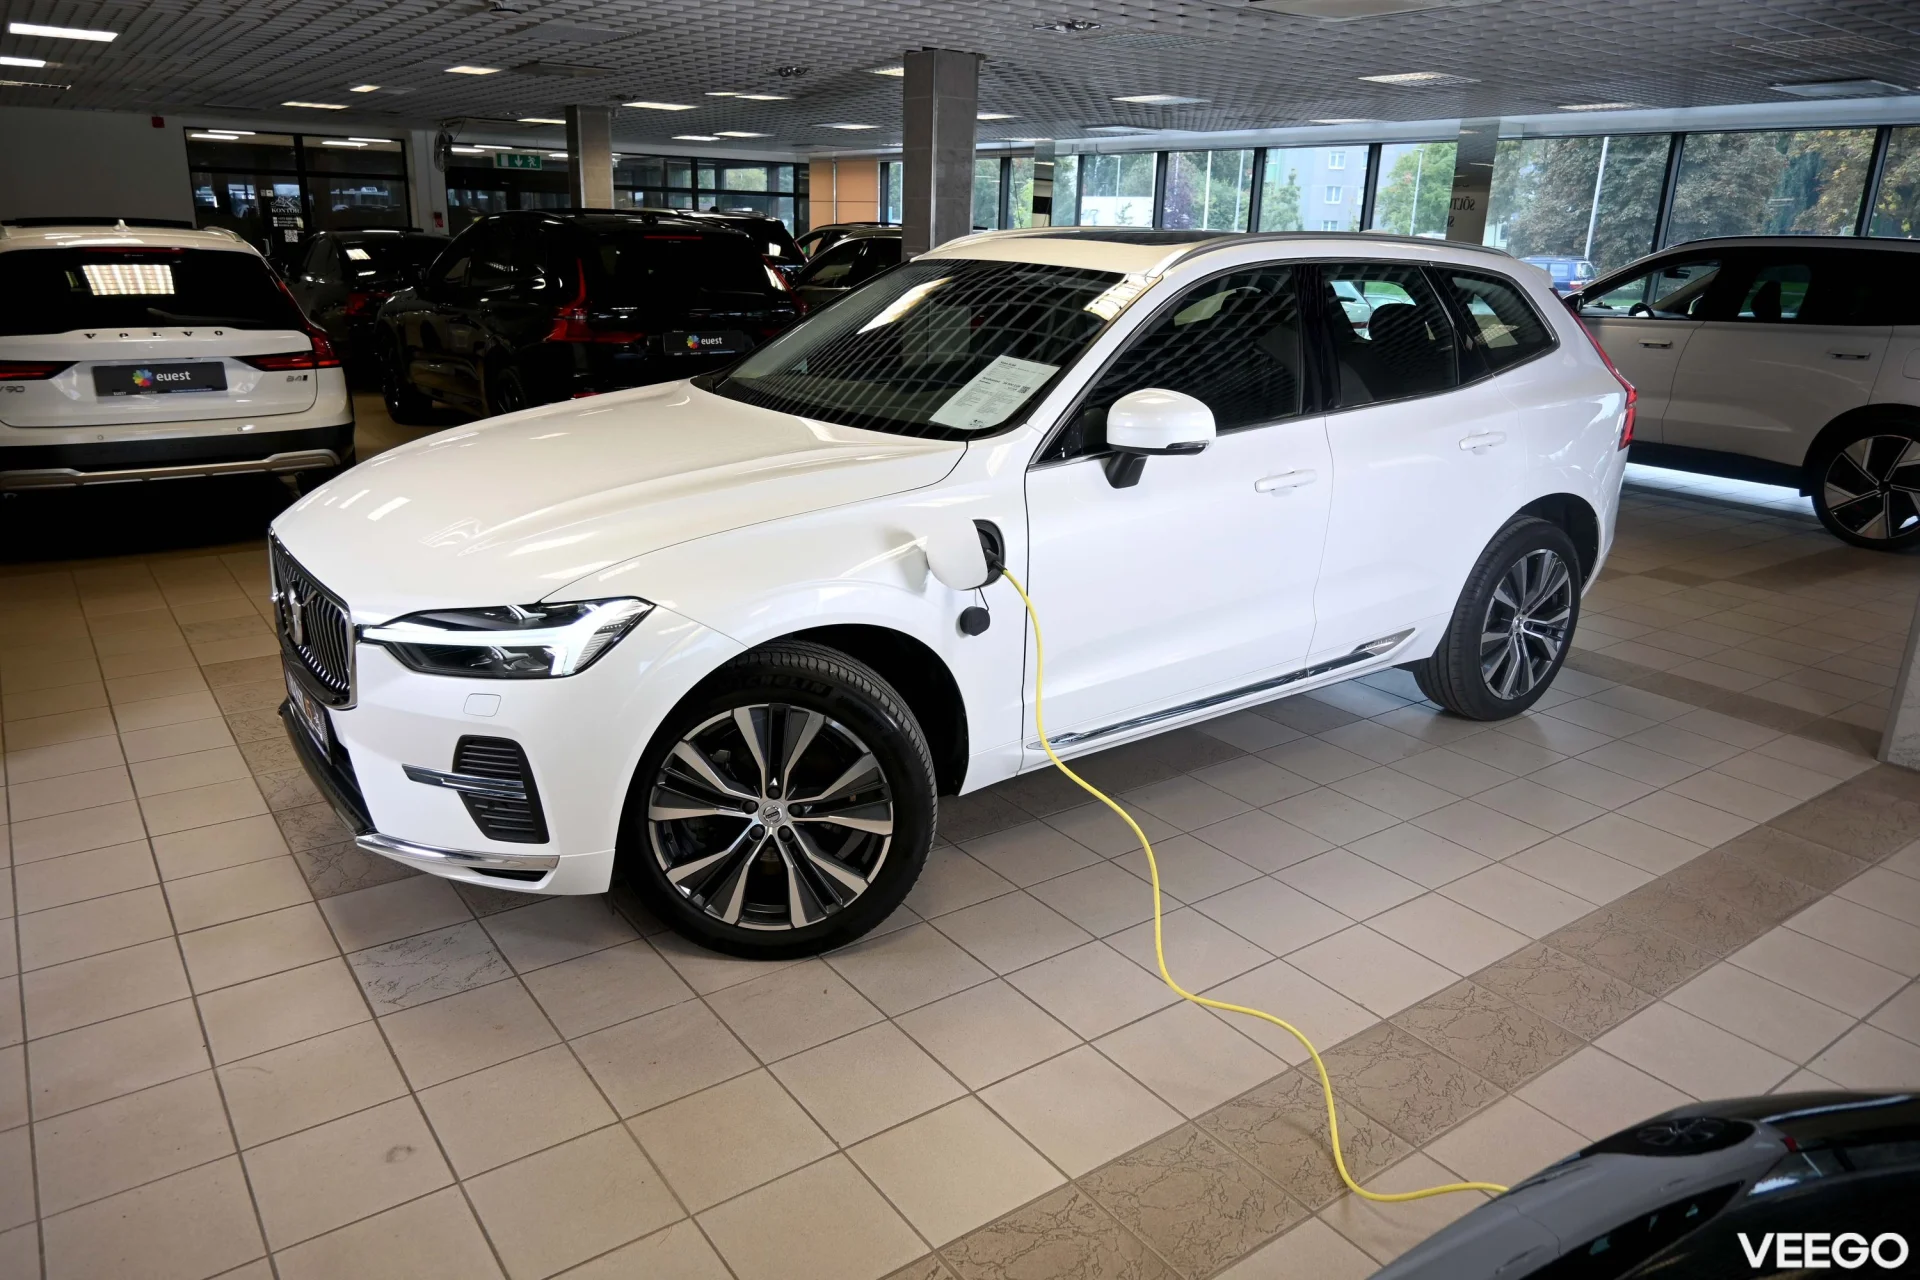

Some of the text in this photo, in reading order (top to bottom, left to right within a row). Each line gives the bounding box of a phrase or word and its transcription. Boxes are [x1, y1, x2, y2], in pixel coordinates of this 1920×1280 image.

[84, 330, 223, 340] VOLVO
[700, 336, 722, 345] euest
[156, 371, 191, 381] euest
